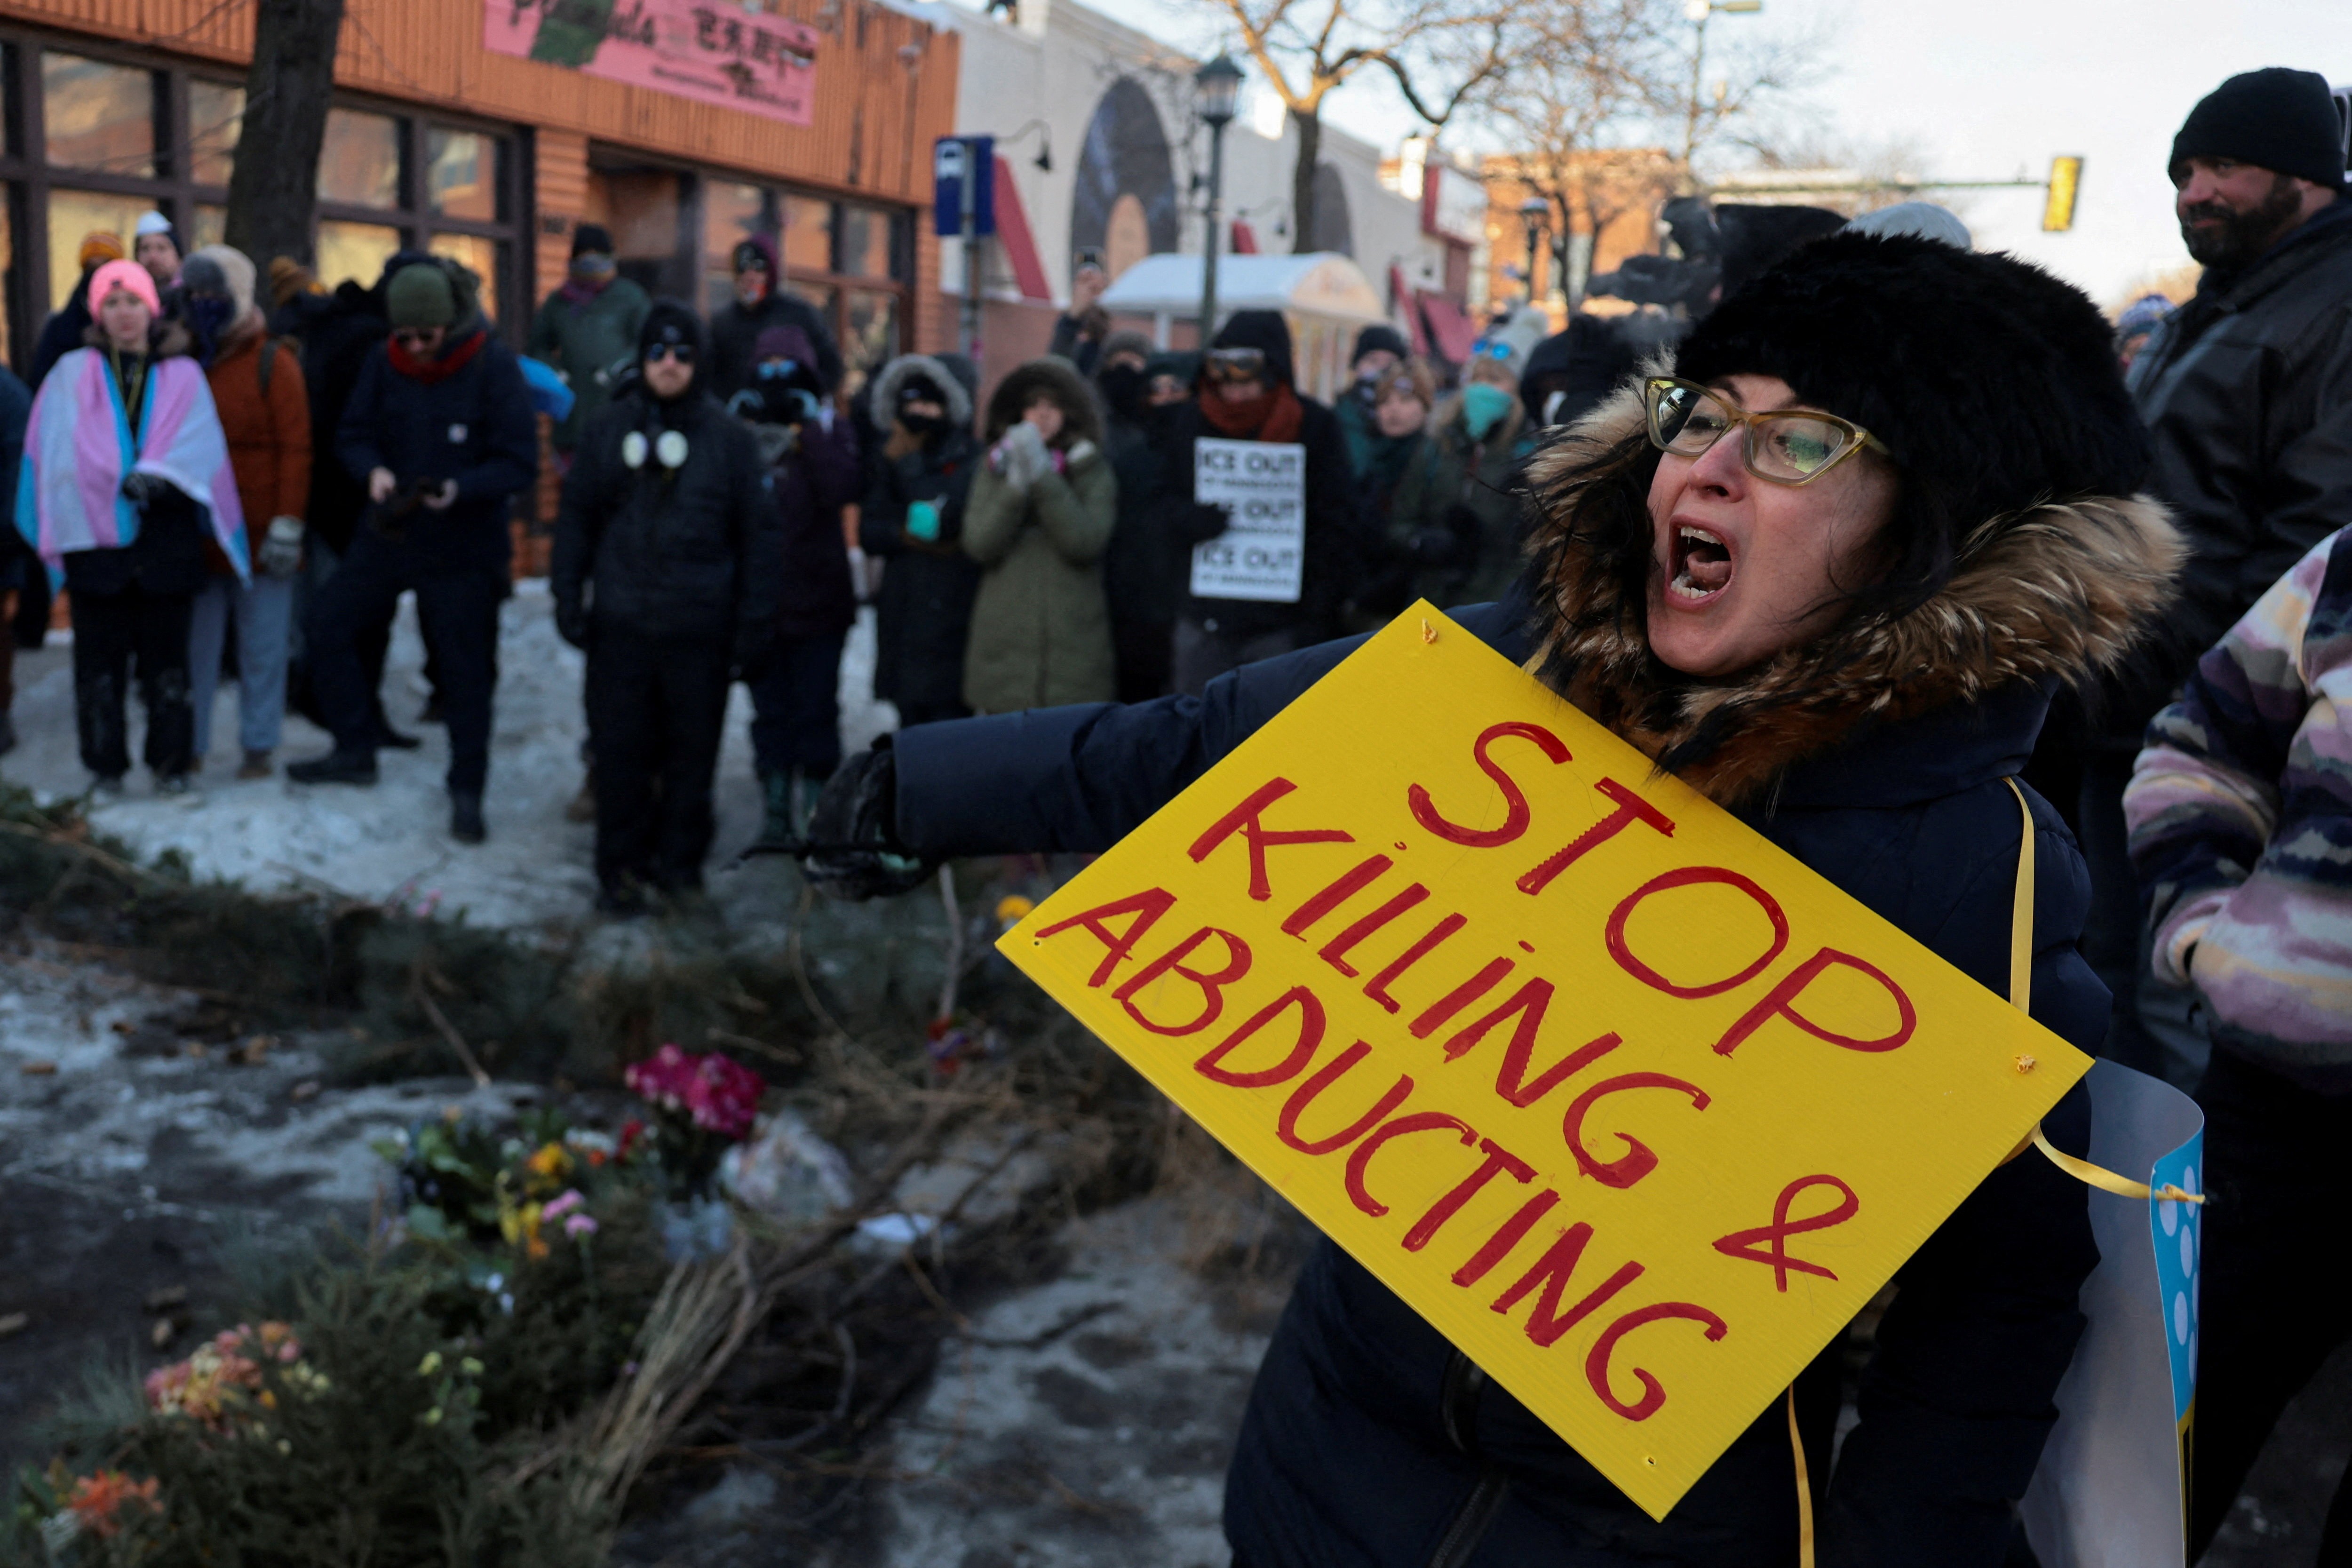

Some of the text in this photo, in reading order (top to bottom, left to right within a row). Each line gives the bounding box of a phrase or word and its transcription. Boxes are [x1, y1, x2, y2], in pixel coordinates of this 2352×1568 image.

[1204, 448, 1296, 475] ICE OUT
[1244, 498, 1296, 521] OUT
[1203, 543, 1295, 571] ICE OUT
[1408, 722, 1916, 1058] STOP
[1035, 888, 1727, 1421] ABDUCTING
[1712, 1175, 1859, 1292] &
